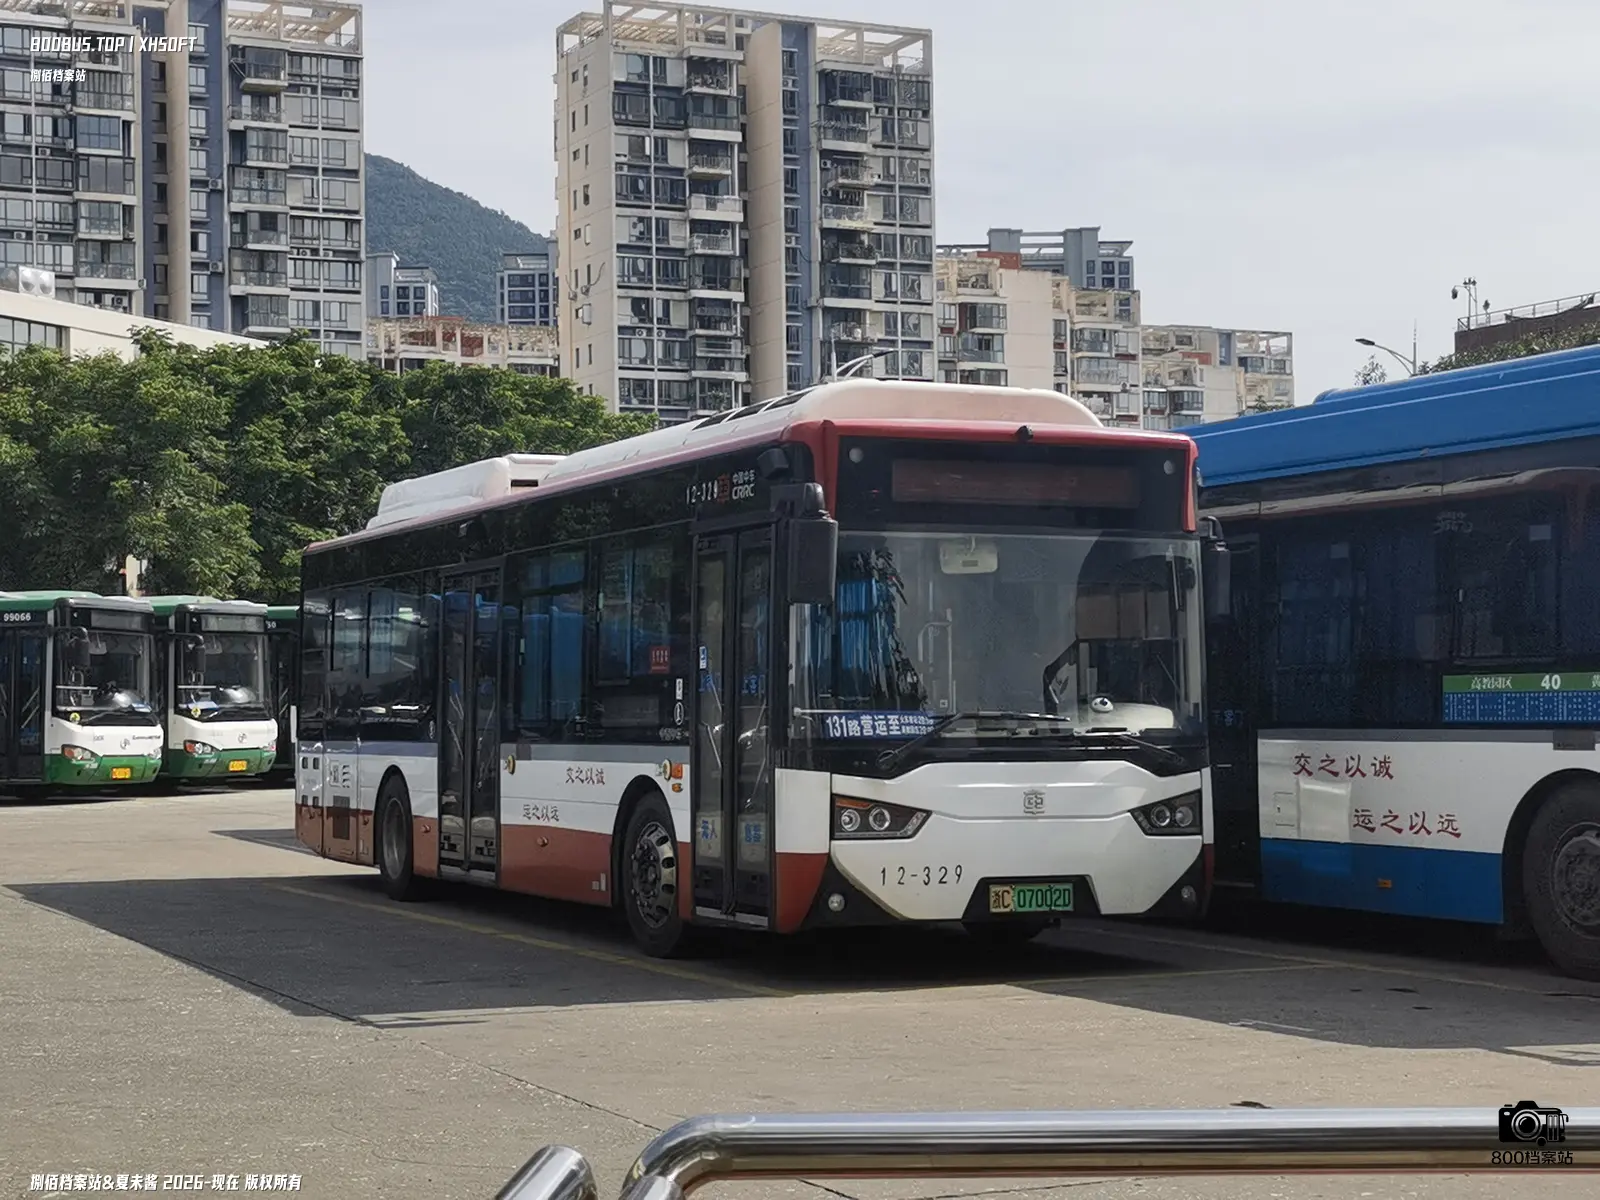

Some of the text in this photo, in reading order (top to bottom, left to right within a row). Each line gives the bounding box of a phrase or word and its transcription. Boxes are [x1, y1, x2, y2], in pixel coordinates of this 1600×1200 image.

[732, 483, 755, 500] CRRC
[1470, 677, 1512, 691] 高教园区
[1540, 674, 1561, 690] 40
[826, 714, 901, 738] 131路营运至
[565, 767, 606, 785] 交之以诚
[1293, 753, 1395, 780] 交之以诚
[522, 803, 560, 822] 运之以远
[1352, 809, 1462, 839] 运之以远
[880, 864, 963, 886] 12-329
